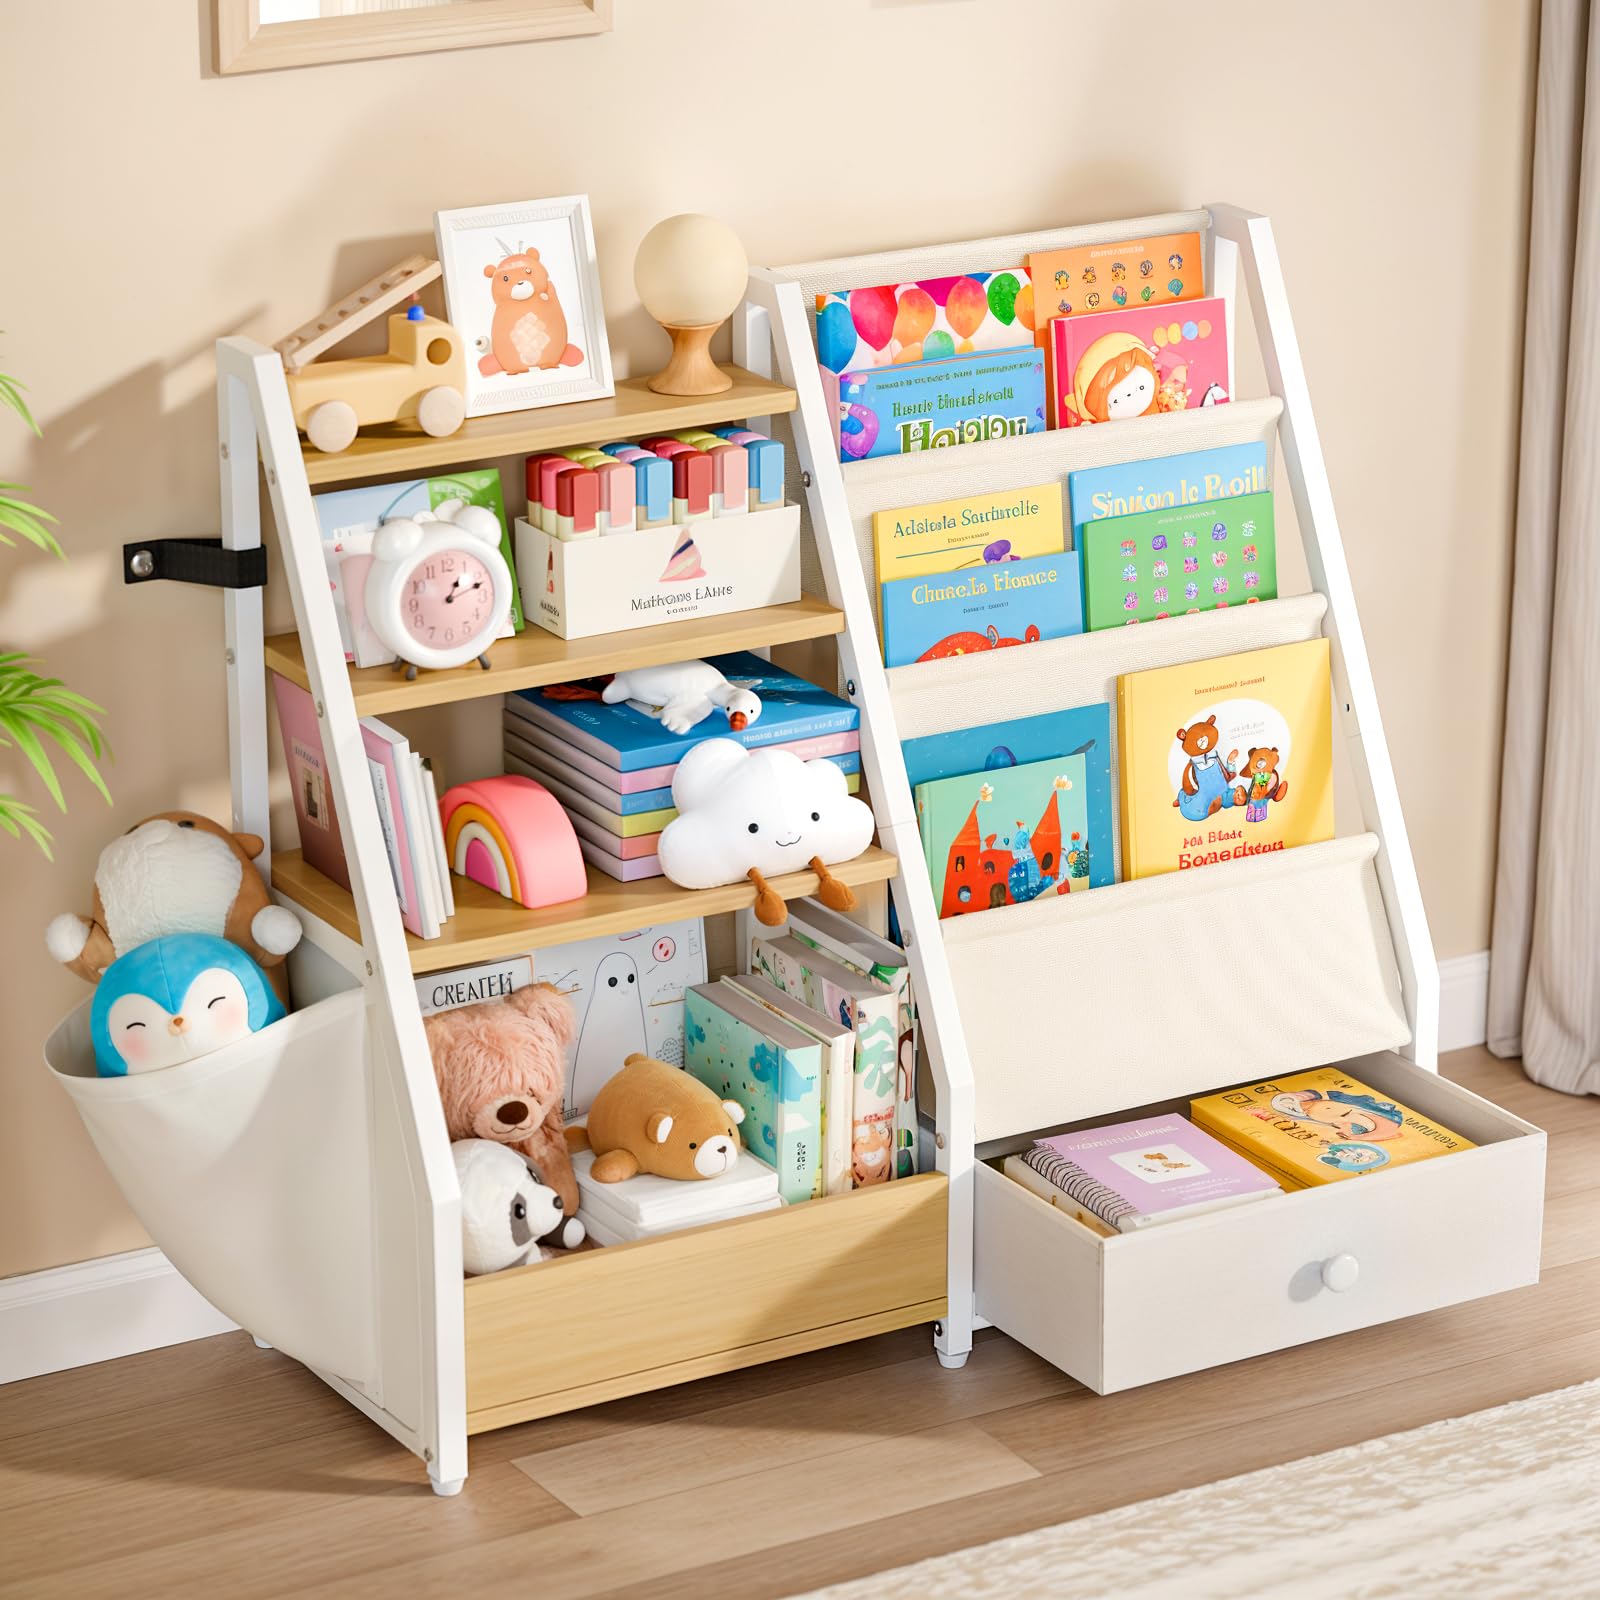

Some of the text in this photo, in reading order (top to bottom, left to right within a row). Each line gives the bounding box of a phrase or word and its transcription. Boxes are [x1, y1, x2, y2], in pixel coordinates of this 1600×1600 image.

[426, 565, 435, 579] 11
[441, 559, 454, 573] 12
[412, 579, 426, 595] 10
[408, 598, 419, 613] 9
[414, 614, 424, 628] 8
[428, 625, 436, 639] 7
[444, 627, 454, 641] 6
